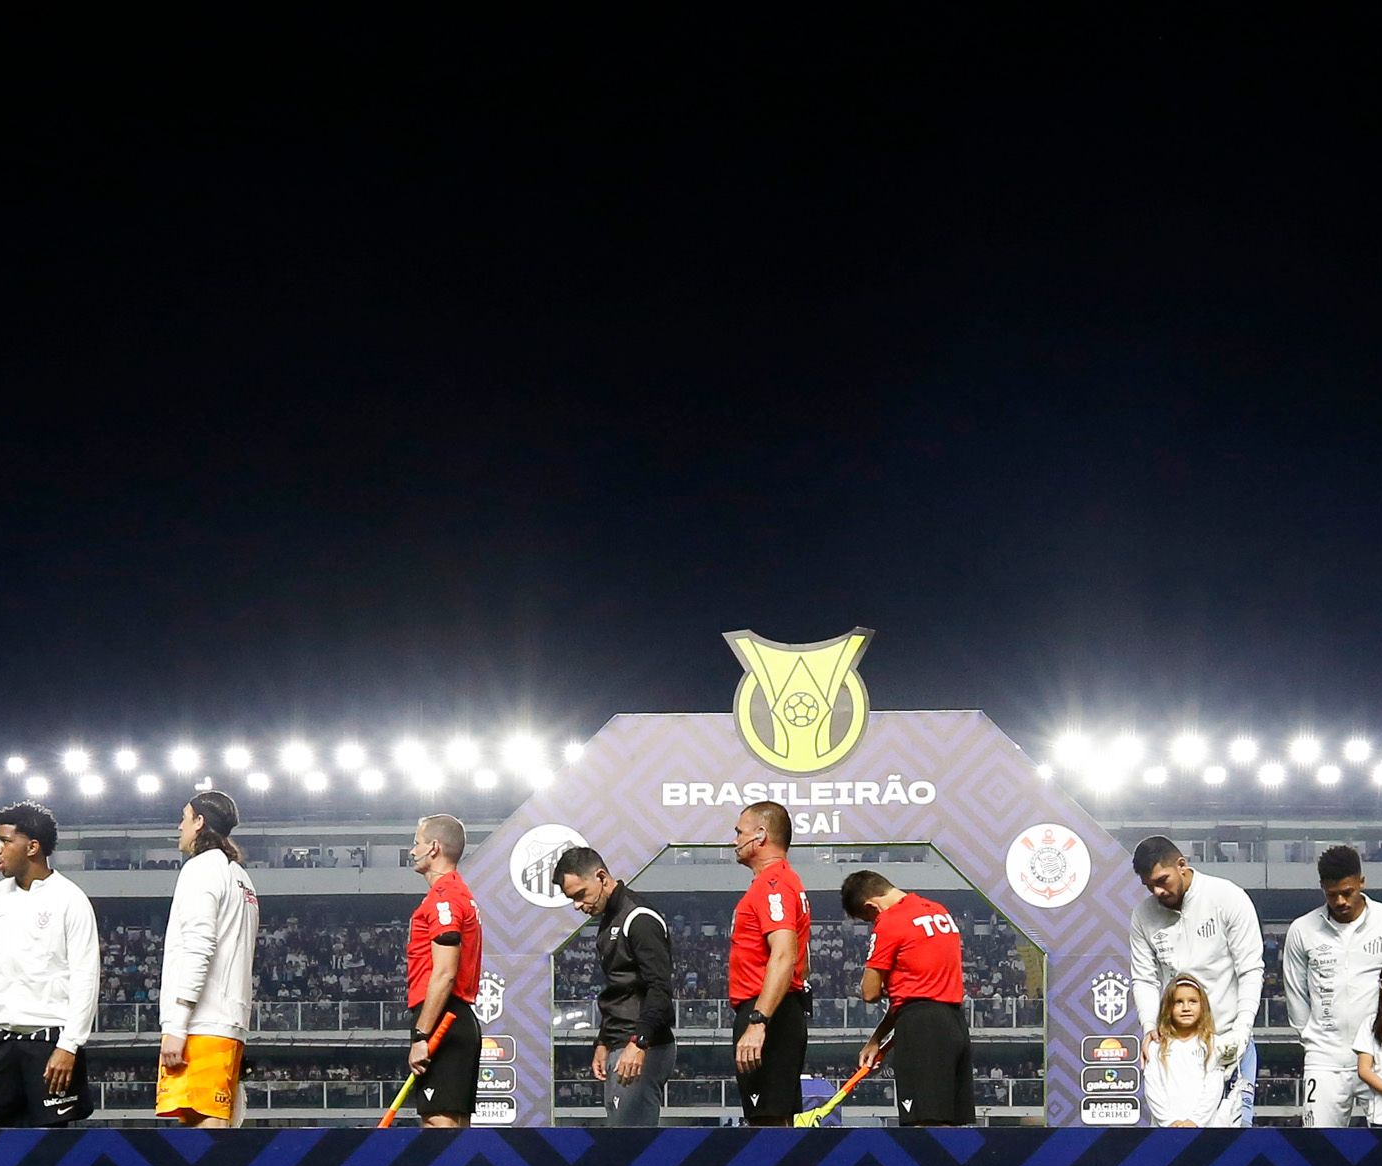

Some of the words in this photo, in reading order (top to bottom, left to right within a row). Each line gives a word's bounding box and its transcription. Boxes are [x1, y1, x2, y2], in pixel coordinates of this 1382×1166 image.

[662, 774, 936, 806] BRASILEIRÃO
[794, 811, 842, 834] SAÍ
[1306, 1078, 1316, 1103] 2
